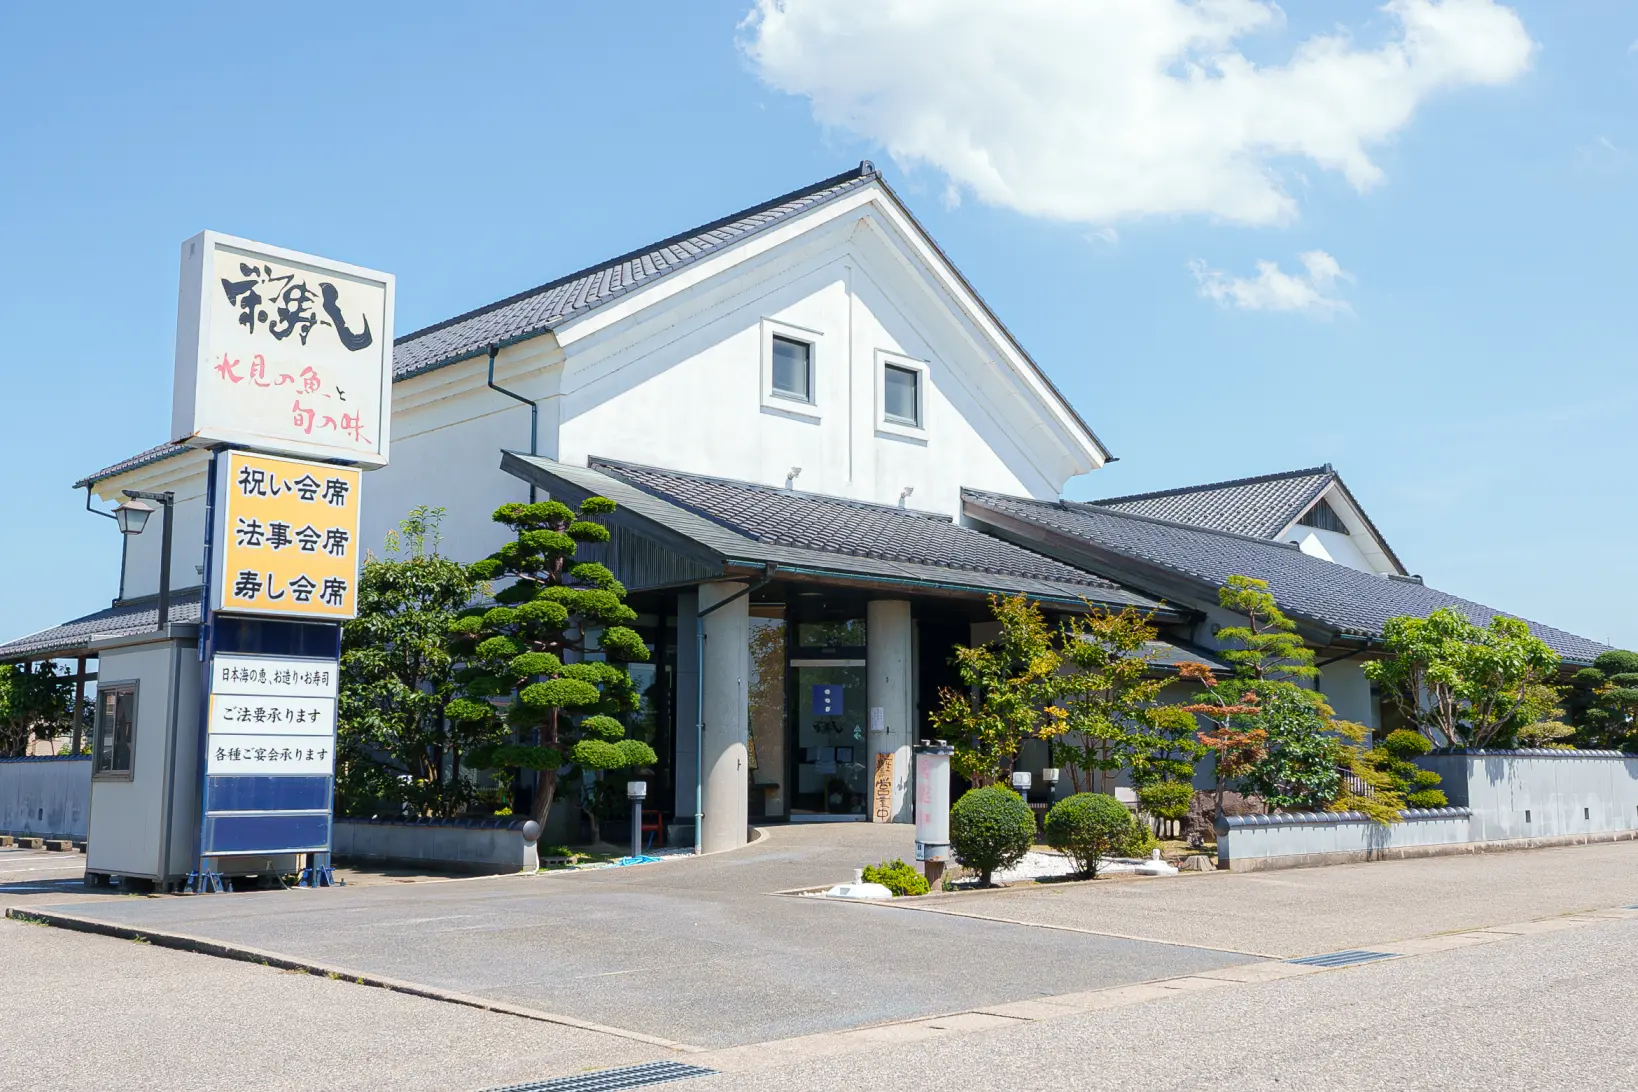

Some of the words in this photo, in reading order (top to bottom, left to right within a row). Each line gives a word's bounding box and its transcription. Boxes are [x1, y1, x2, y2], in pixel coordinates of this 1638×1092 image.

[292, 399, 372, 444] 旬の味
[238, 466, 349, 506] 祝い会席
[236, 518, 349, 556] 法事会席
[234, 570, 347, 606] 寿し会席
[223, 706, 321, 724] ご法要承ります
[215, 746, 328, 762] 各種ご宴会承ります
